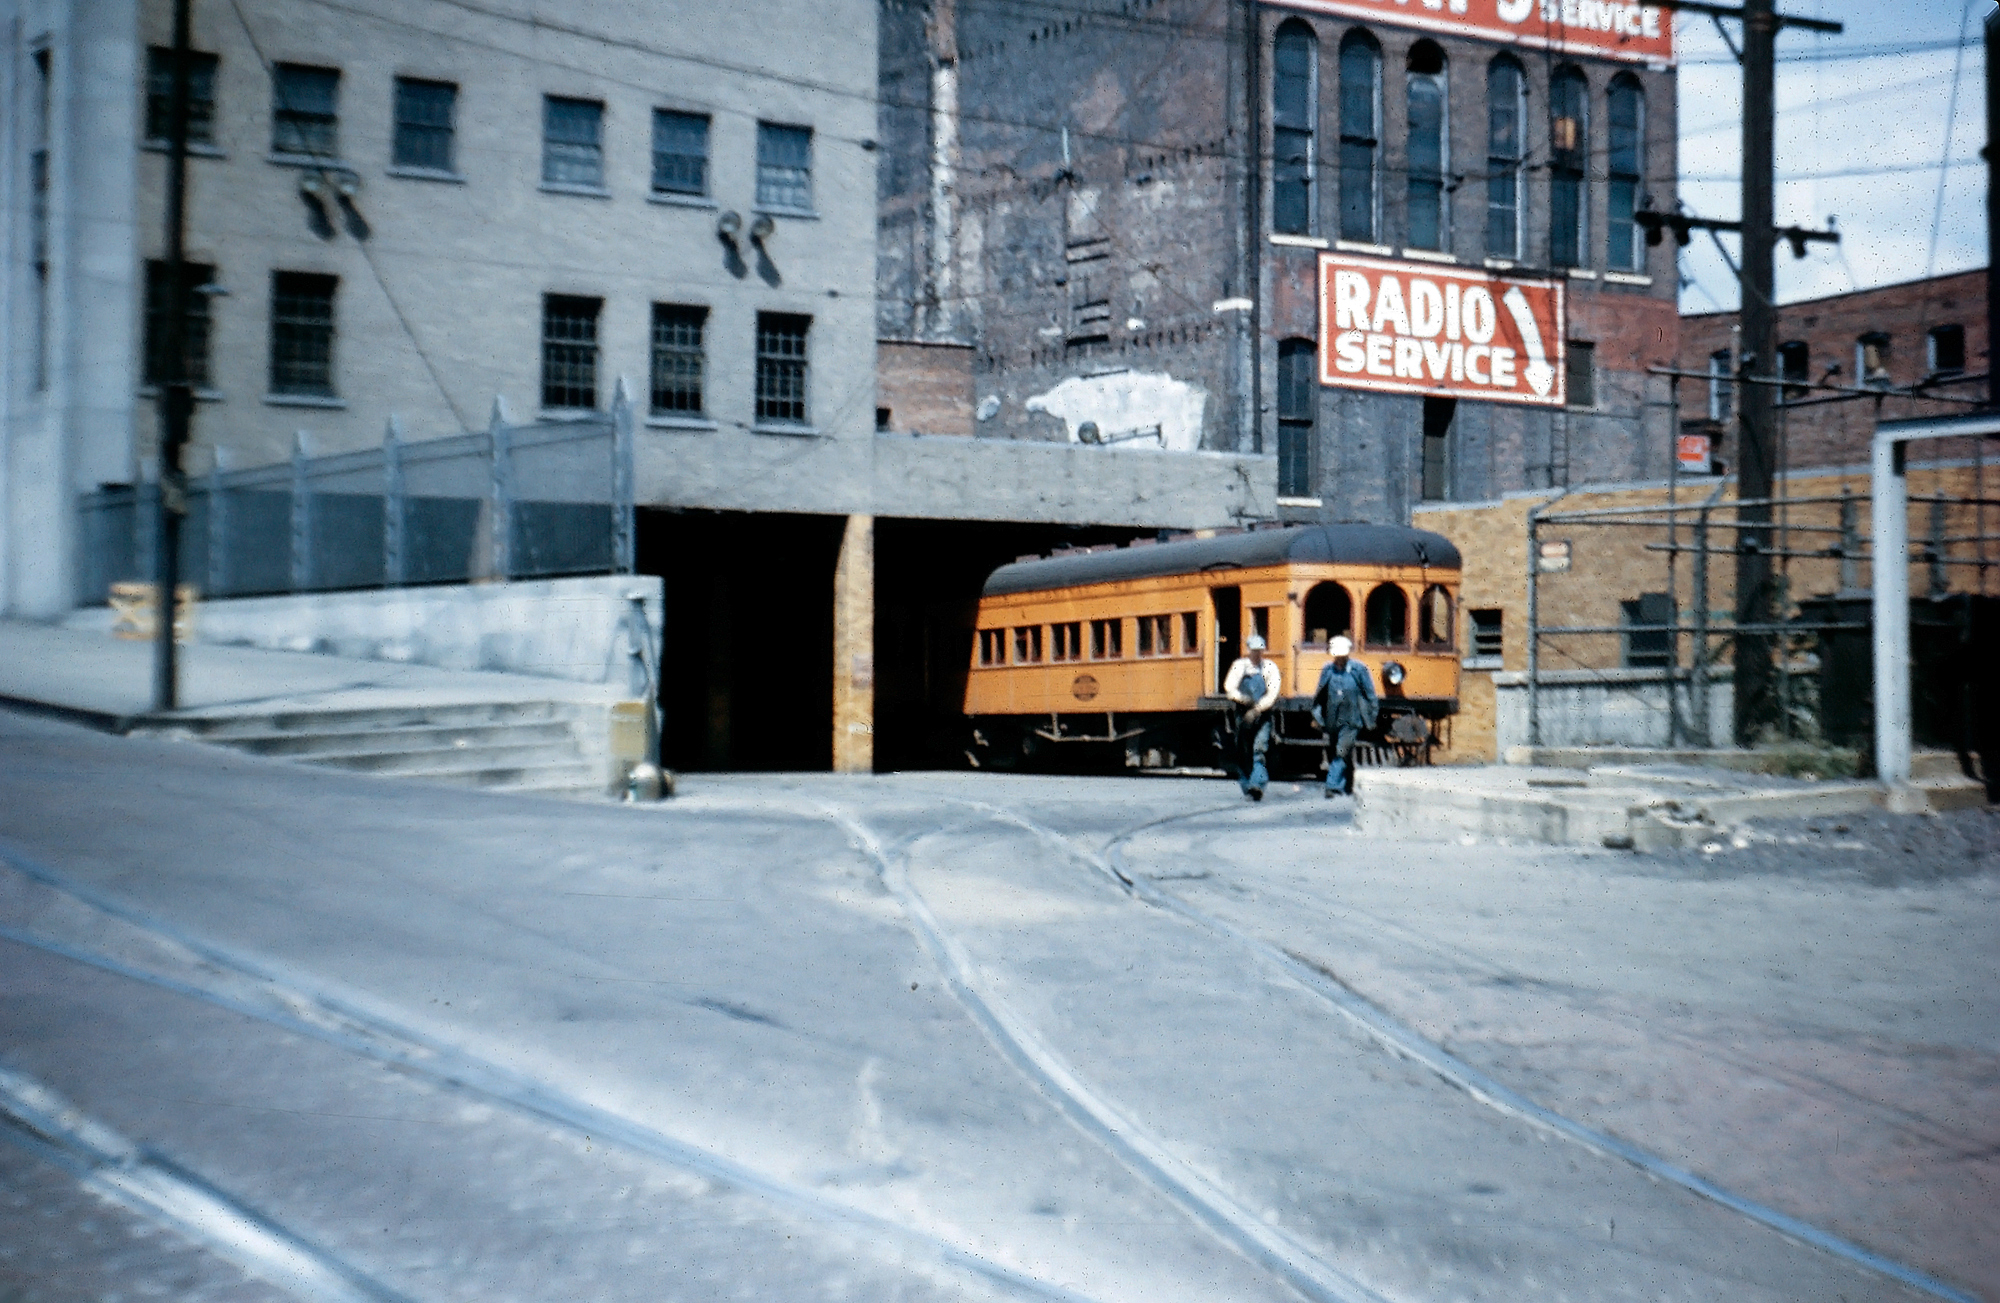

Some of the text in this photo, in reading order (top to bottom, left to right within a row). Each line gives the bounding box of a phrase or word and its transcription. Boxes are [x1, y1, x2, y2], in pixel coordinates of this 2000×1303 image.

[1540, 0, 1660, 38] SERVICE
[1335, 269, 1496, 344] RADIO
[1335, 330, 1518, 387] SERVICE
